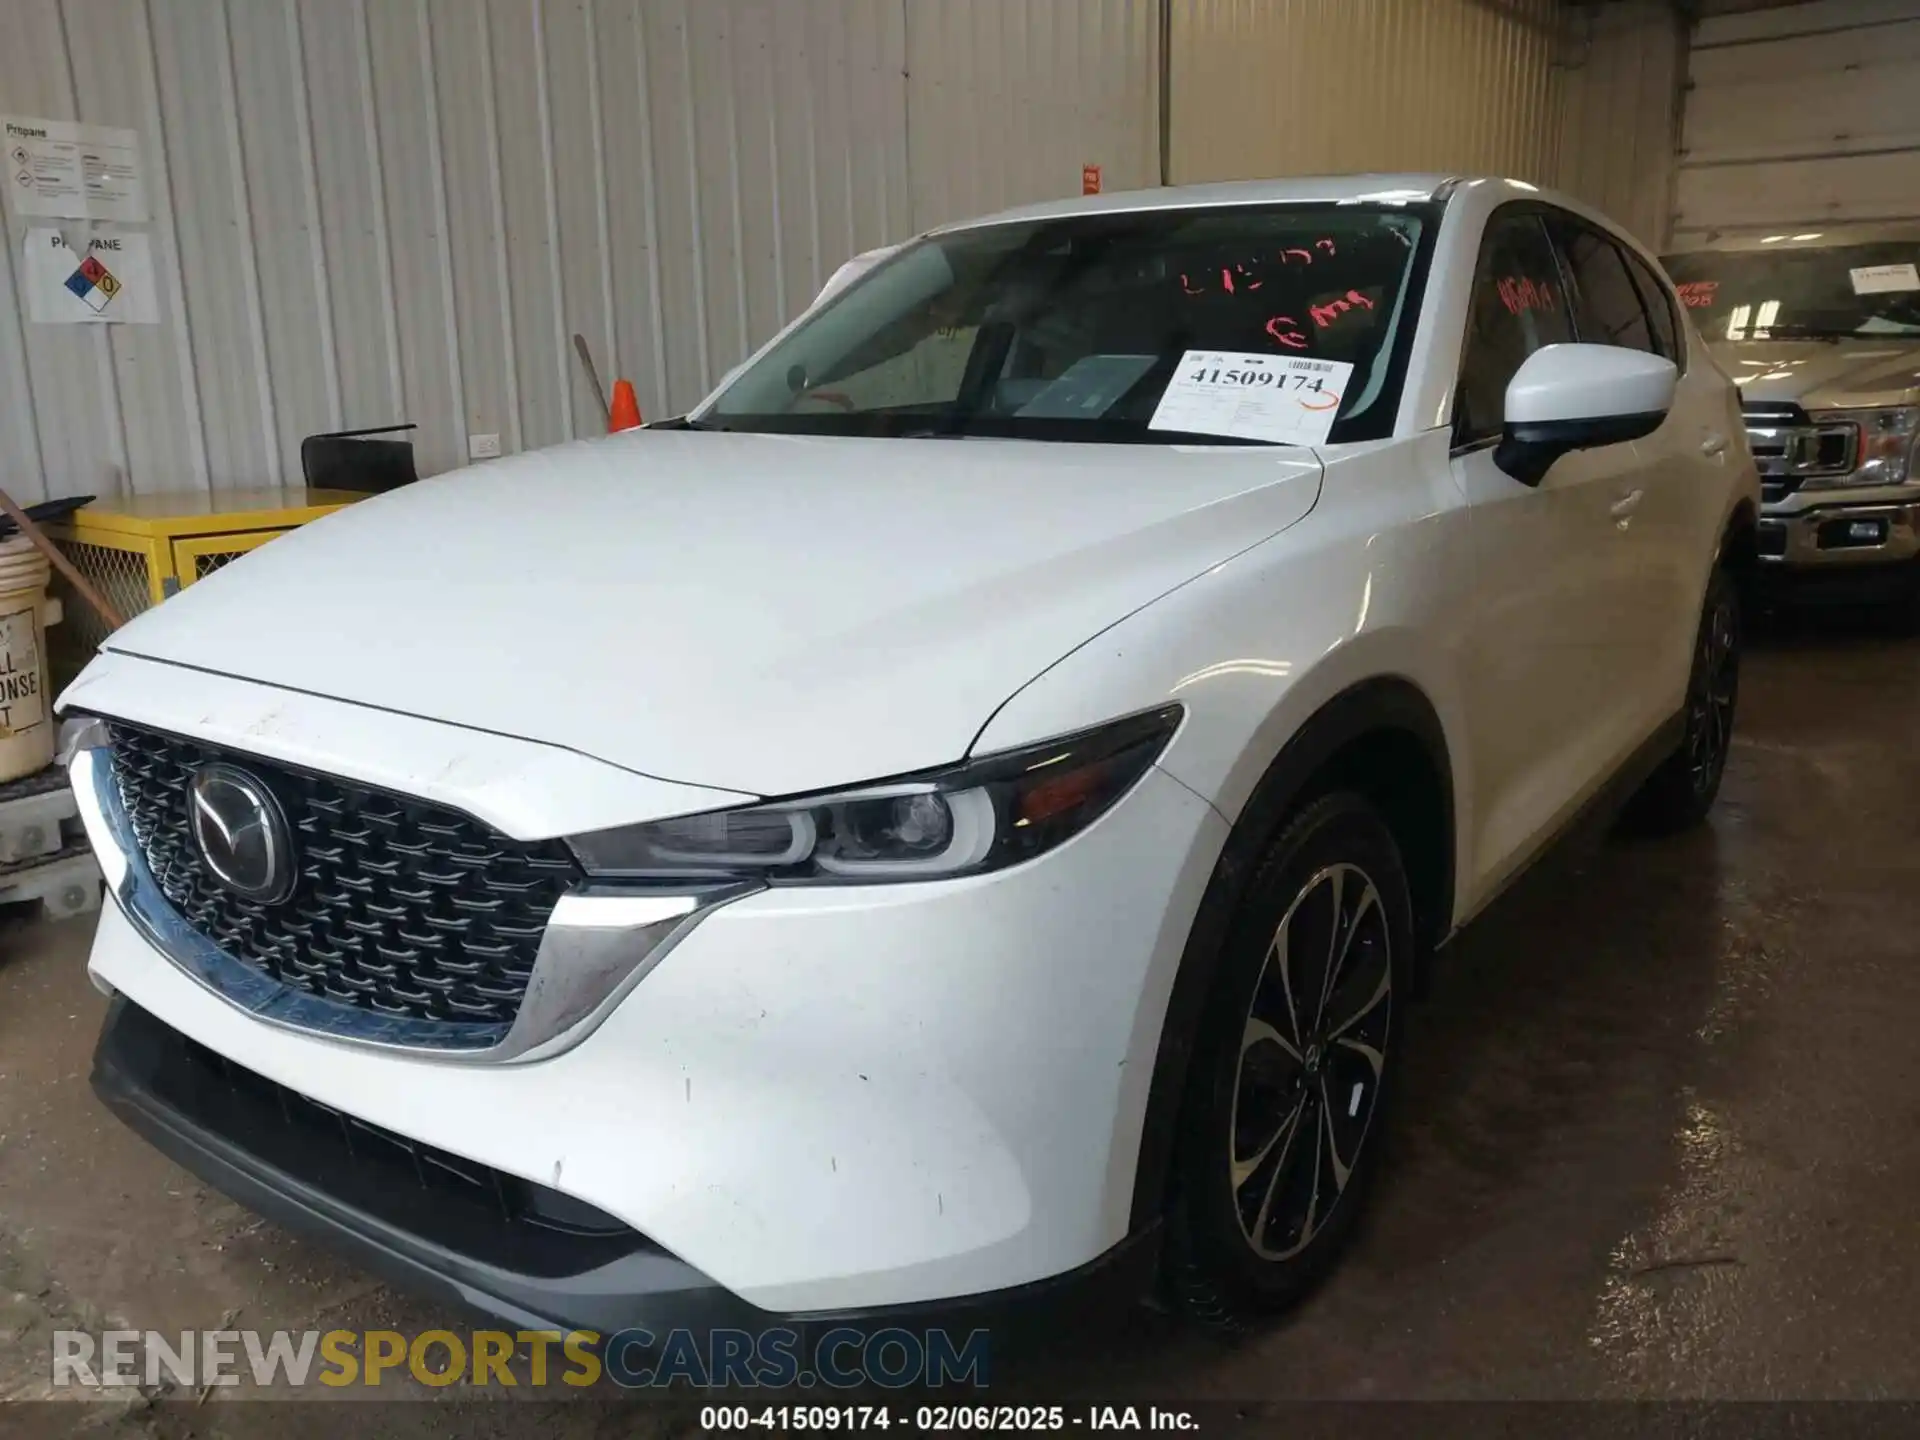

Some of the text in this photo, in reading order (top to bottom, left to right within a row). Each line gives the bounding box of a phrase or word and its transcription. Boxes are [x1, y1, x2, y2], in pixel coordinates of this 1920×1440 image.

[51, 236, 122, 250] PANE
[102, 275, 114, 292] 0
[1190, 367, 1324, 393] 41509174
